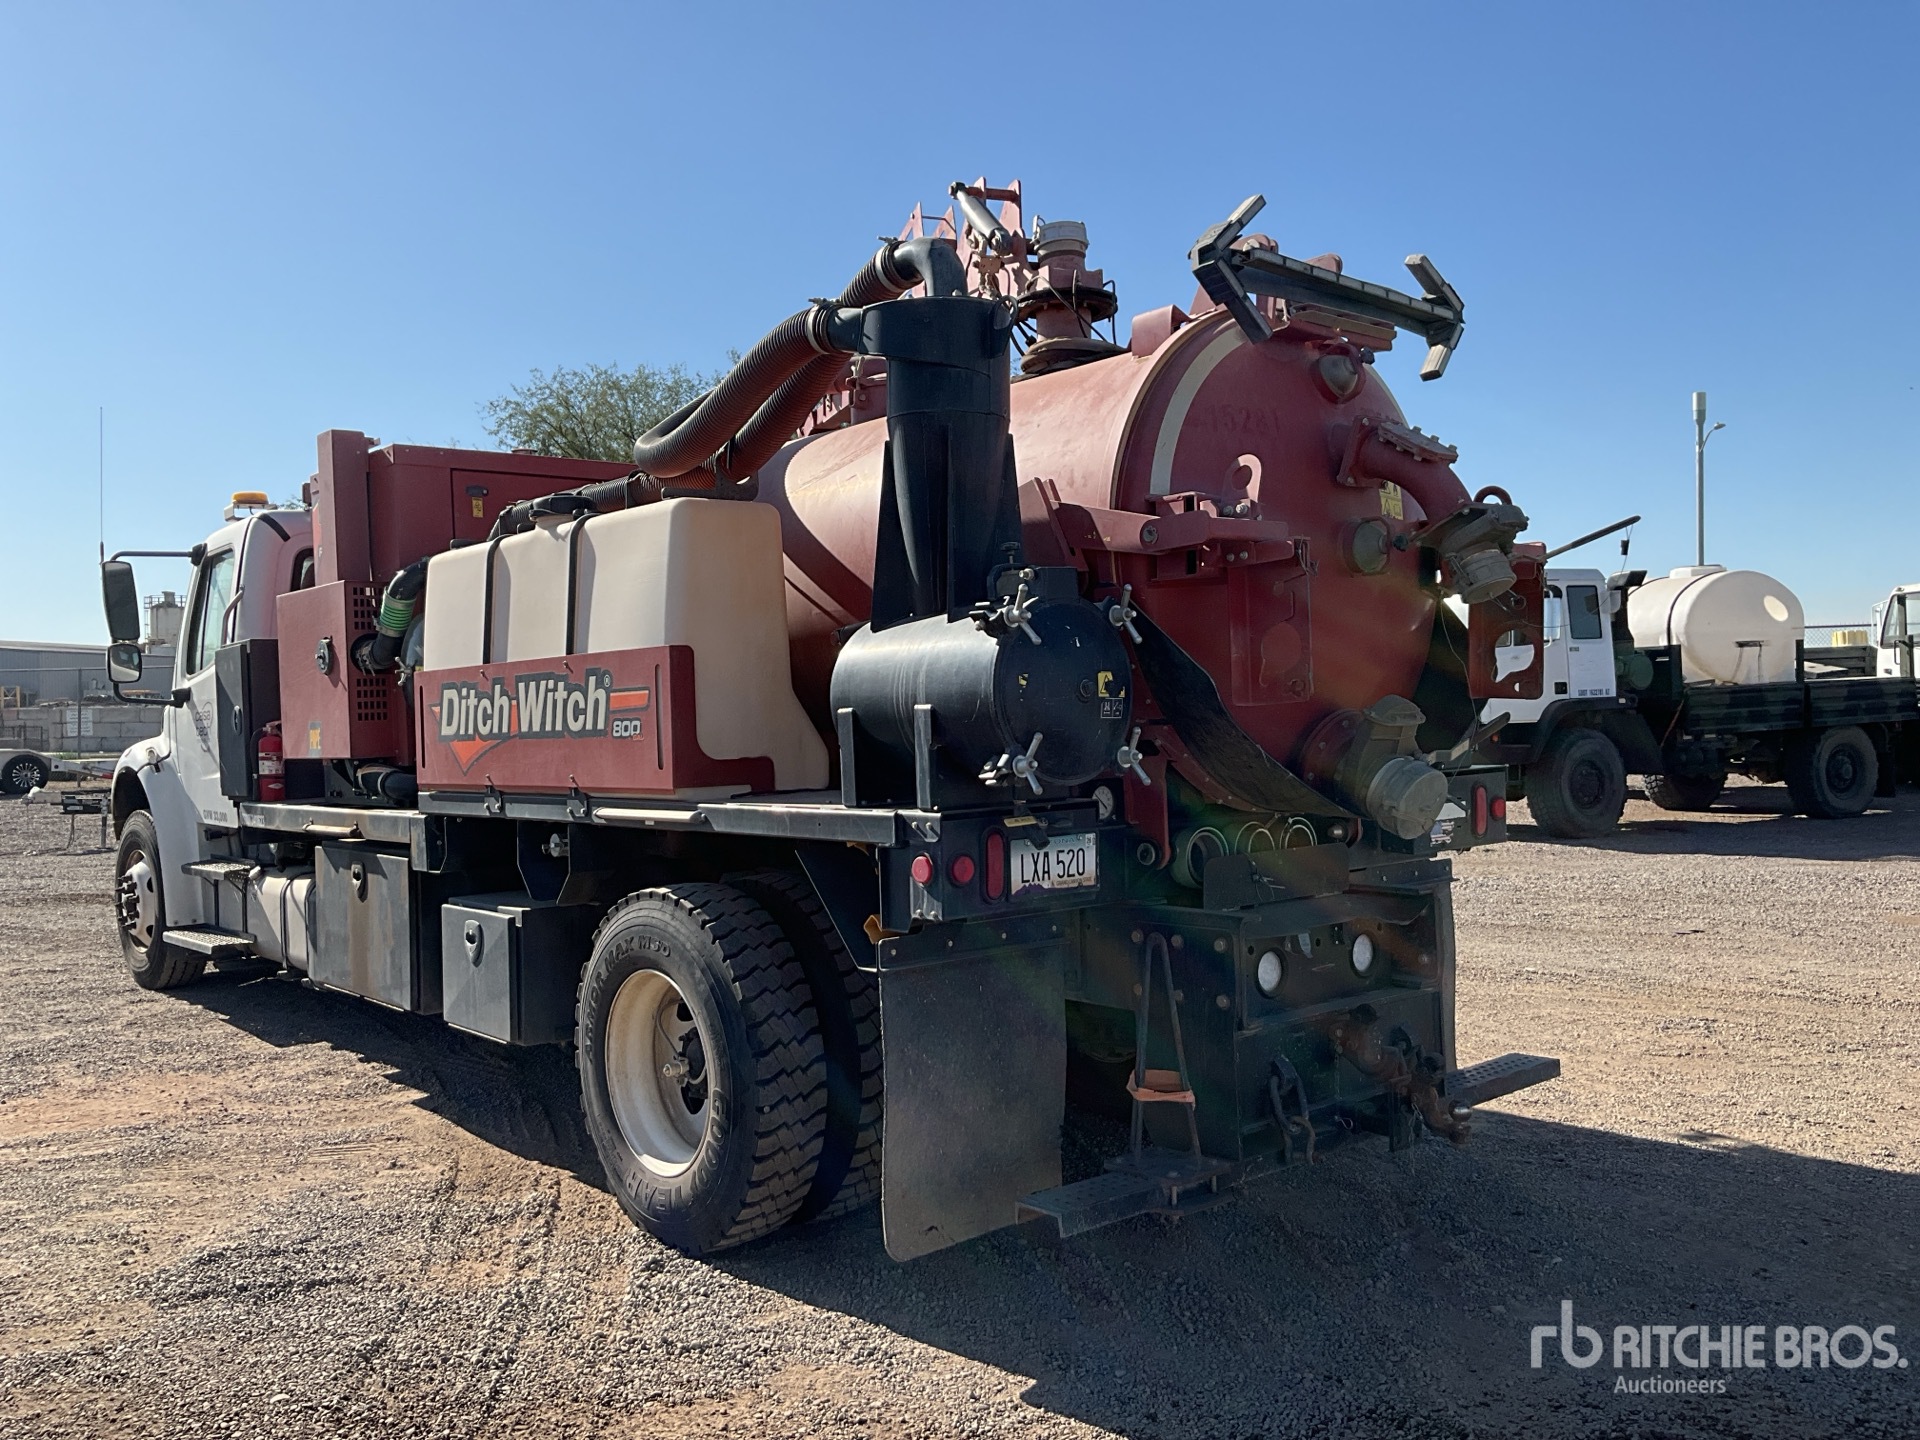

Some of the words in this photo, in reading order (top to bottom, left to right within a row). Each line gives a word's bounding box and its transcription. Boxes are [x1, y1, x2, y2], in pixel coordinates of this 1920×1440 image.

[441, 684, 511, 736] Ditch
[518, 675, 608, 733] Witch
[612, 720, 641, 737] 800
[1021, 851, 1051, 884] LXA
[1056, 848, 1086, 879] 520
[604, 936, 635, 973] MAX
